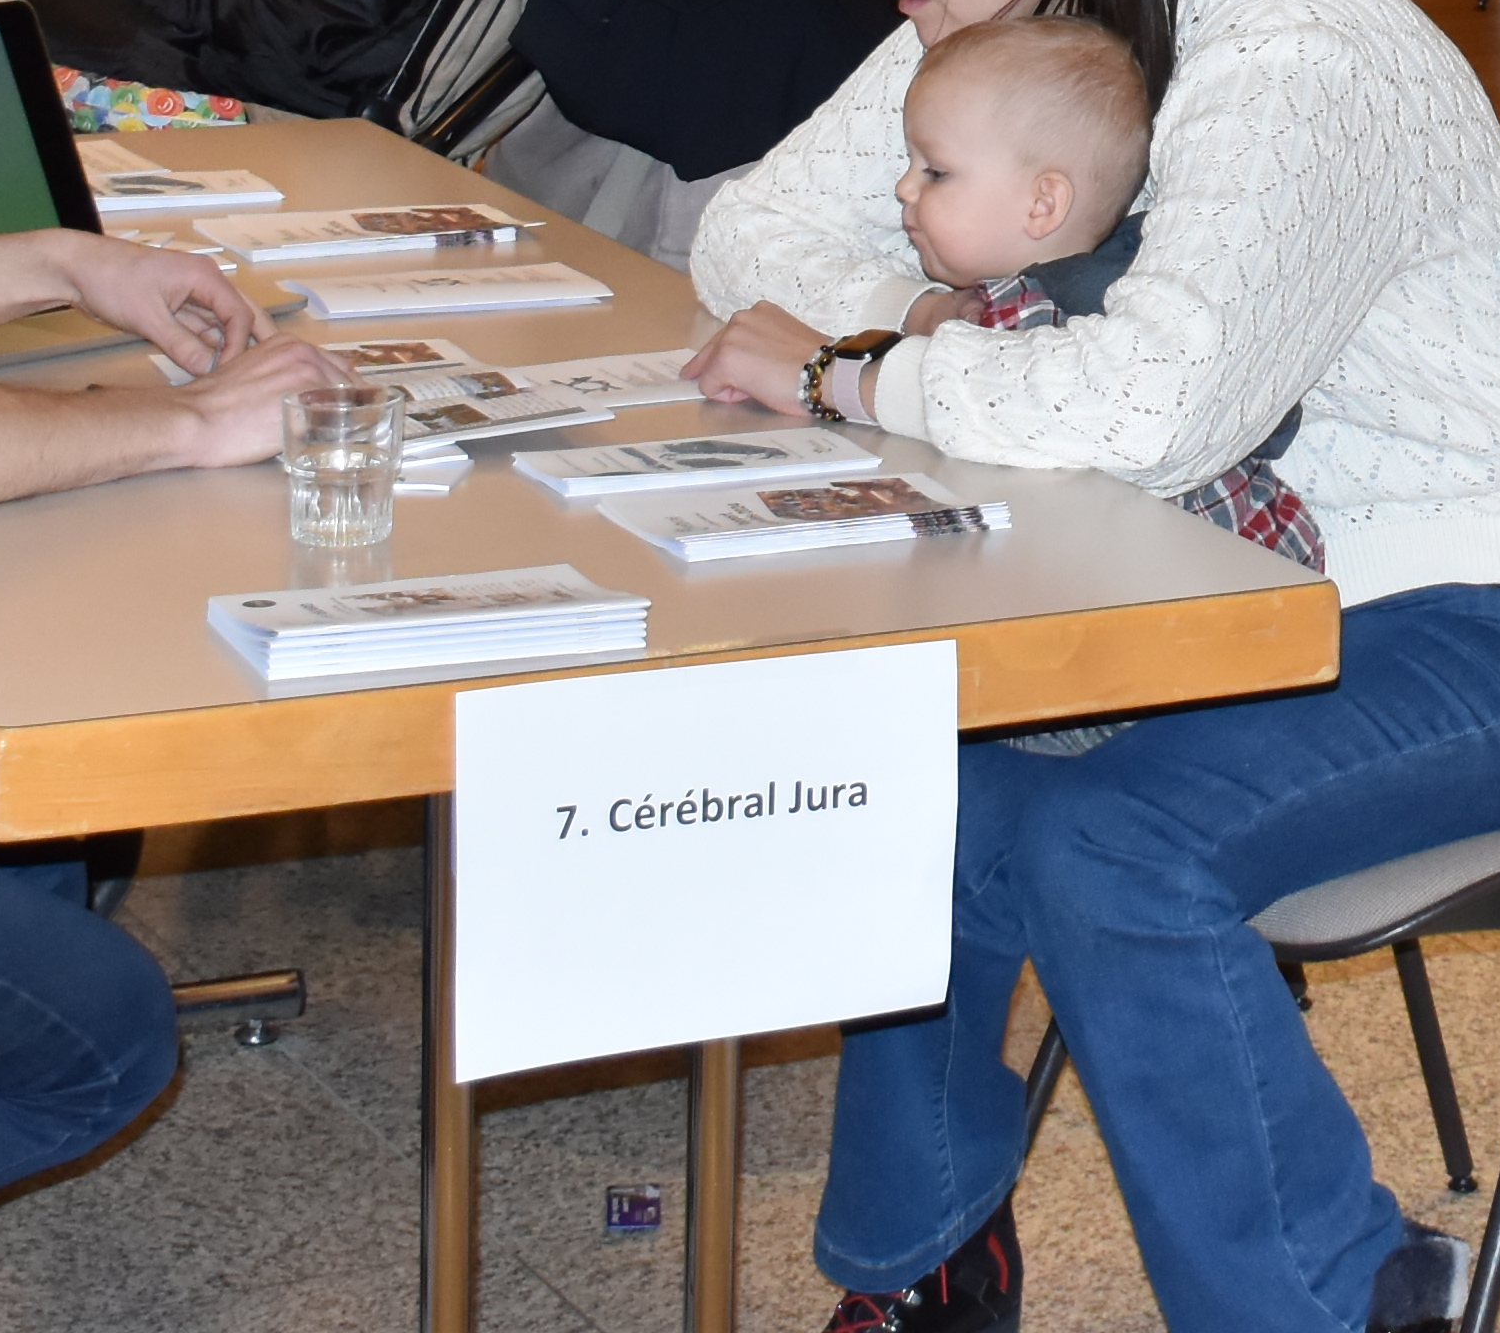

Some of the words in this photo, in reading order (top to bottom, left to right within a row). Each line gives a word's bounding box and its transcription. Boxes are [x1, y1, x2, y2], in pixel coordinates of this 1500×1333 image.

[555, 804, 590, 840] 7.
[608, 780, 776, 833] Cérébral
[787, 780, 869, 814] Jura
